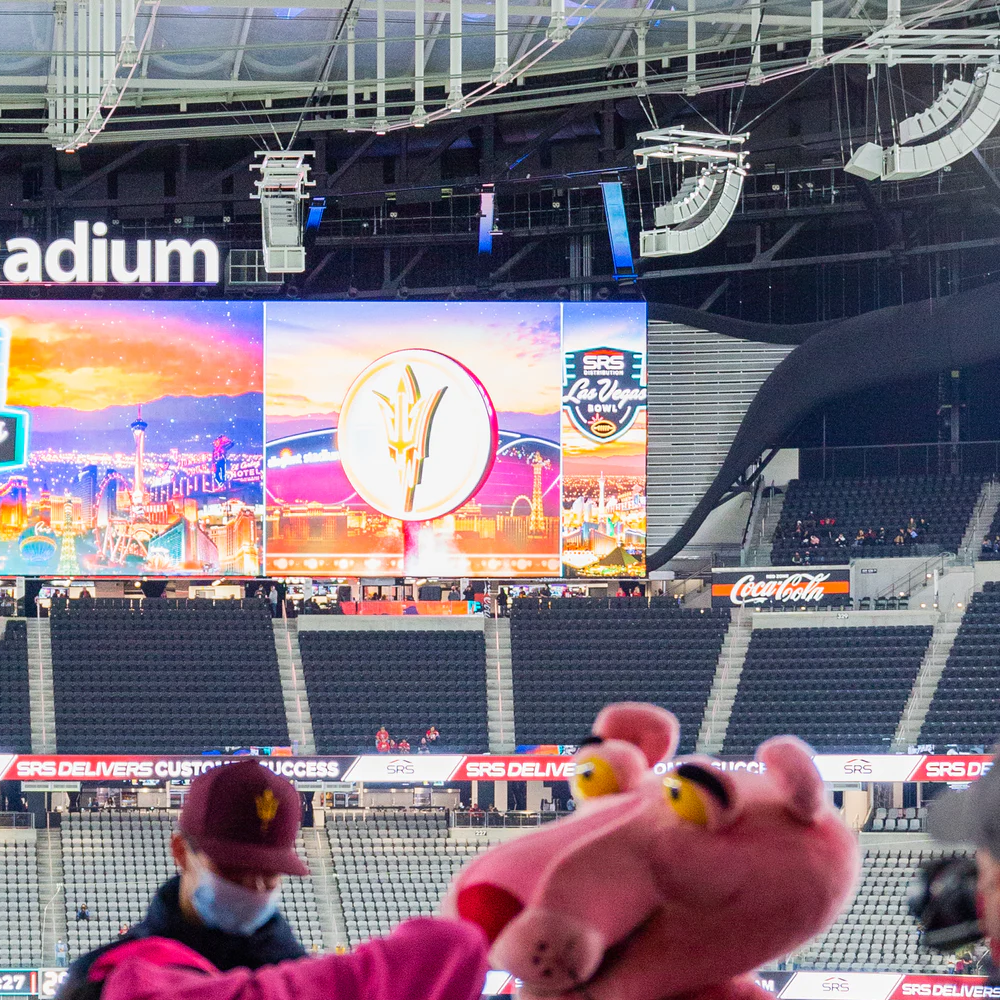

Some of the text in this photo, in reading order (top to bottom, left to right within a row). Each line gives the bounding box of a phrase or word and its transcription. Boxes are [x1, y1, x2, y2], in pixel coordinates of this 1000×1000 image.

[582, 354, 625, 370] SRS
[562, 377, 647, 410] Las Vegas
[587, 403, 618, 413] BOWL
[729, 572, 831, 605] Coca-Cola
[16, 761, 57, 777] SRS
[57, 760, 155, 777] DELIVERS
[386, 764, 415, 775] SRS
[465, 762, 576, 778] SRS DELIVE
[843, 764, 873, 775] SRS
[925, 761, 967, 777] SRS
[821, 982, 850, 993] SRS
[902, 983, 932, 996] SRS
